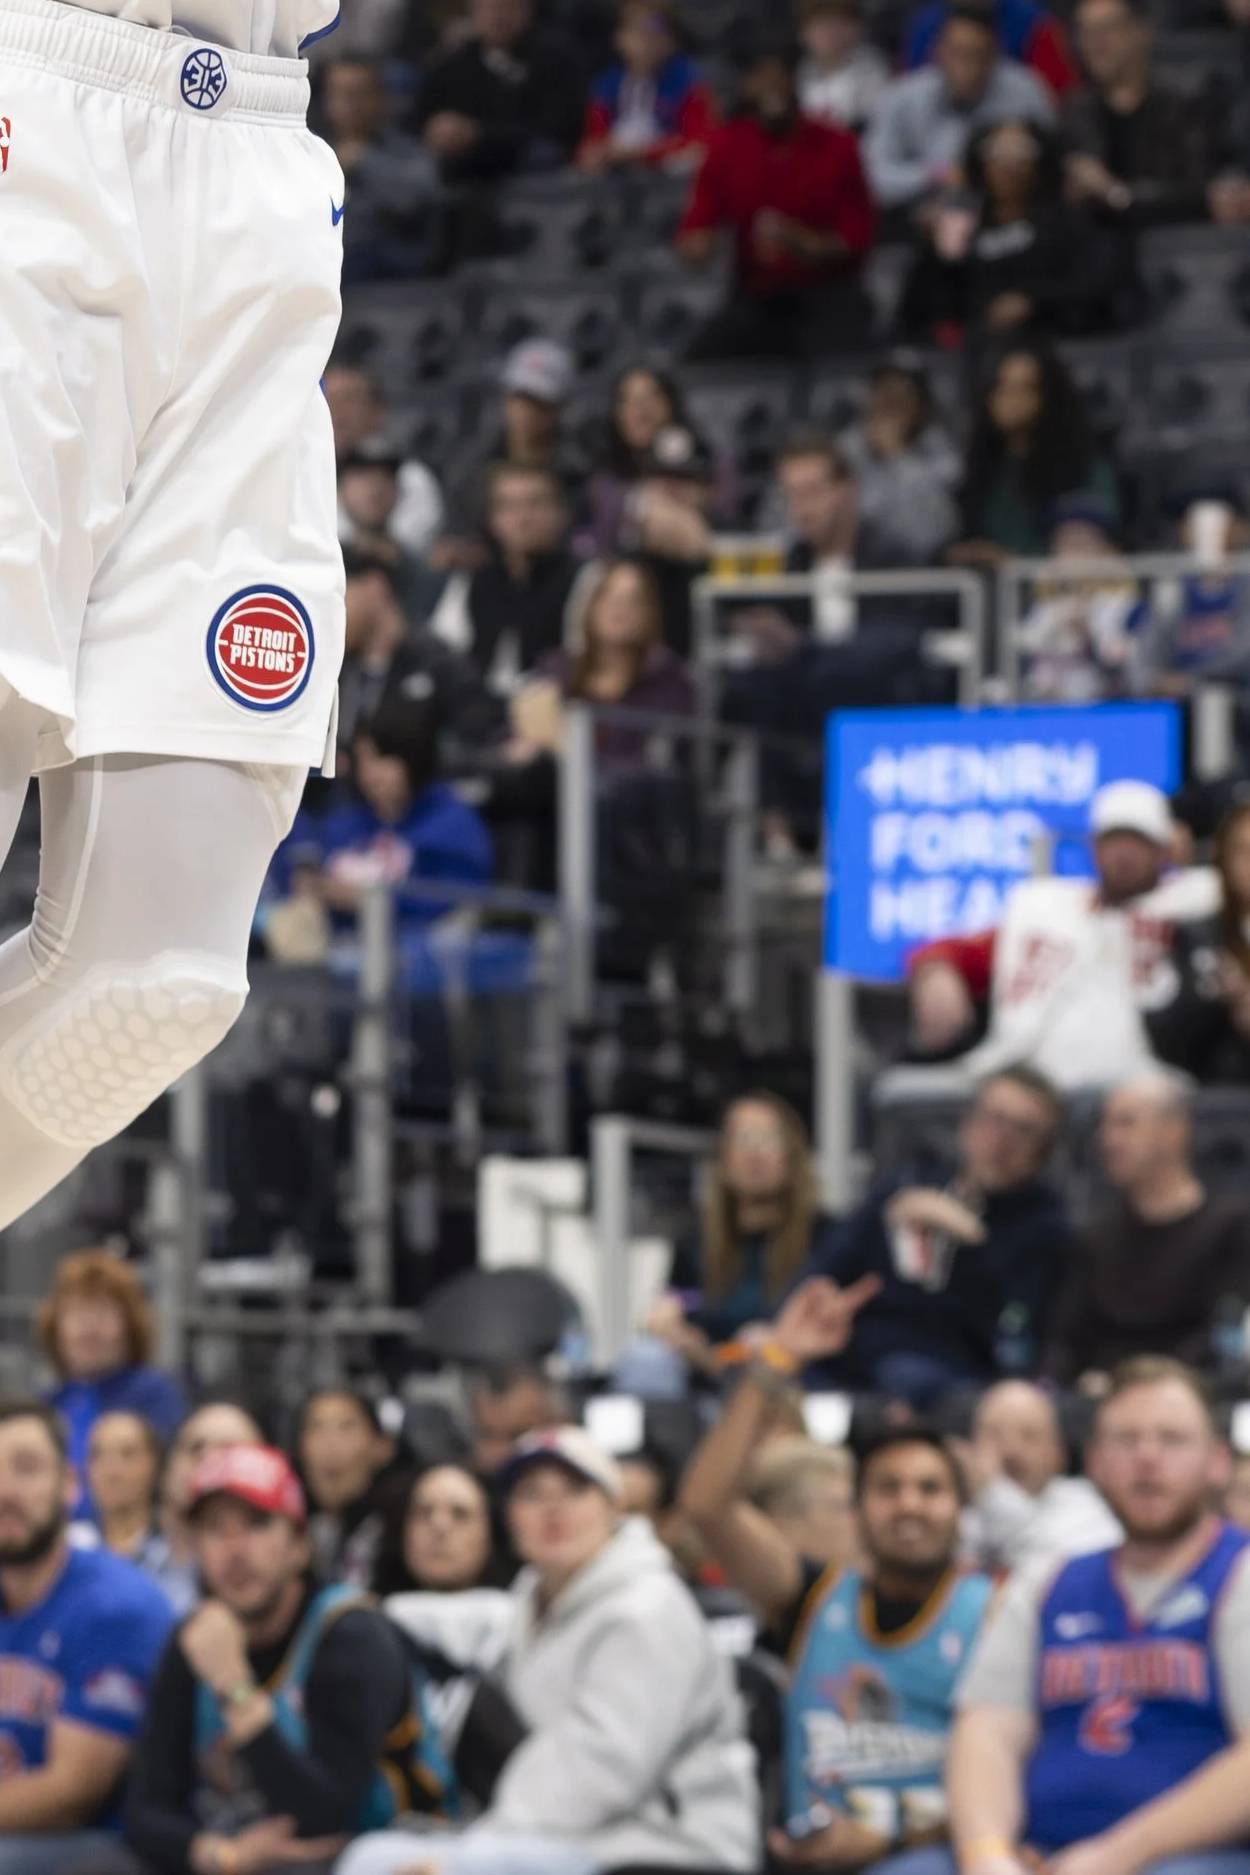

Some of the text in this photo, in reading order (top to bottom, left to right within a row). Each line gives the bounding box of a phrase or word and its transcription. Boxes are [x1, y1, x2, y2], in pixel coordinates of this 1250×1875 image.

[229, 644, 296, 674] PISTONS
[232, 623, 298, 653] DETROIT
[863, 740, 1099, 807] HENRY
[869, 877, 1008, 941] HEA
